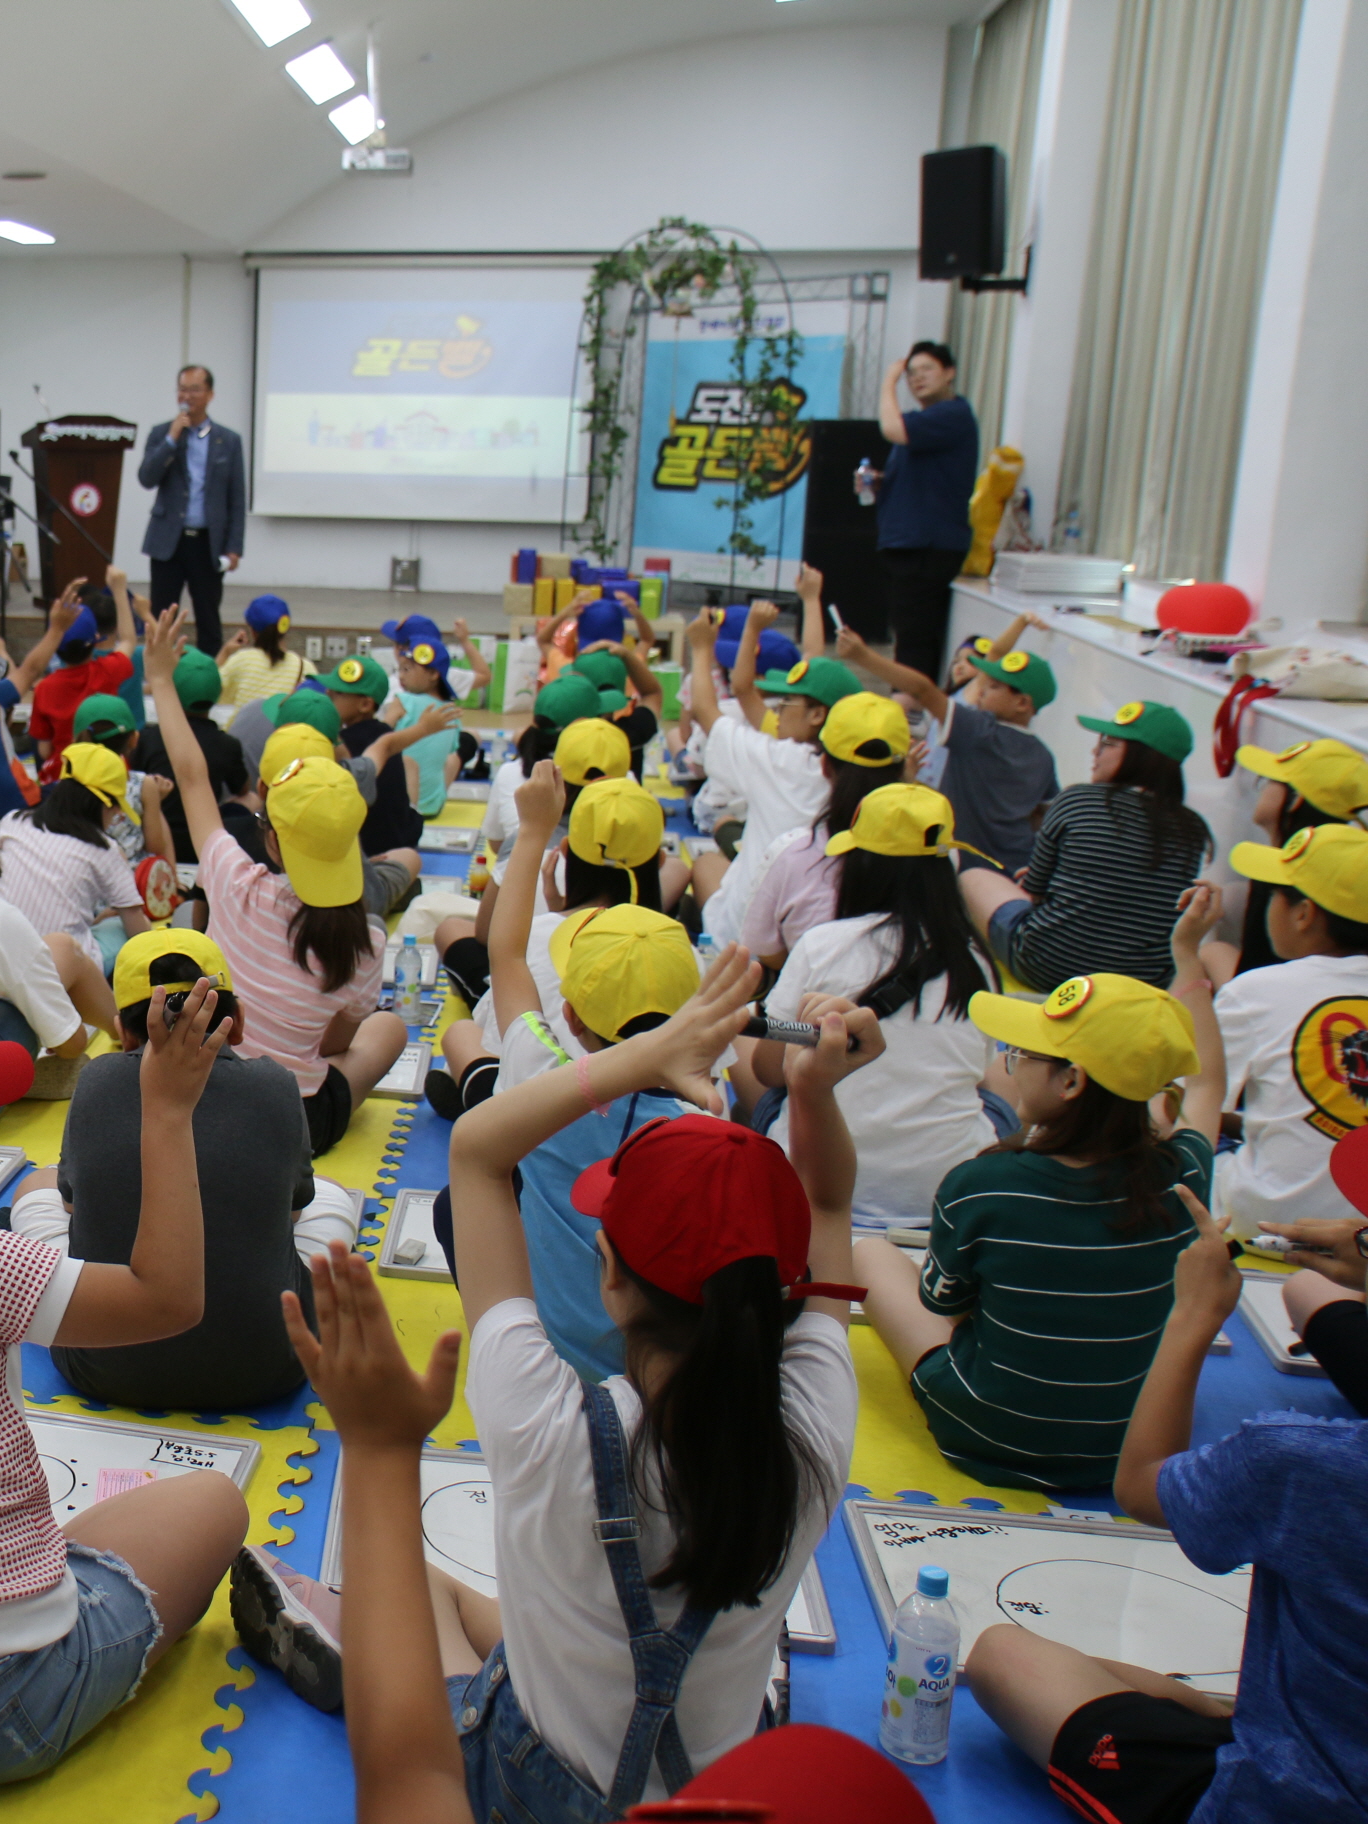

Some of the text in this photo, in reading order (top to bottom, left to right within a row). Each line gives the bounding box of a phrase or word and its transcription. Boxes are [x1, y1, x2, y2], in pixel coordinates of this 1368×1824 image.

[1058, 985, 1076, 1006] 58
[768, 1019, 813, 1033] BOARD
[918, 1678, 950, 1693] AQUA
